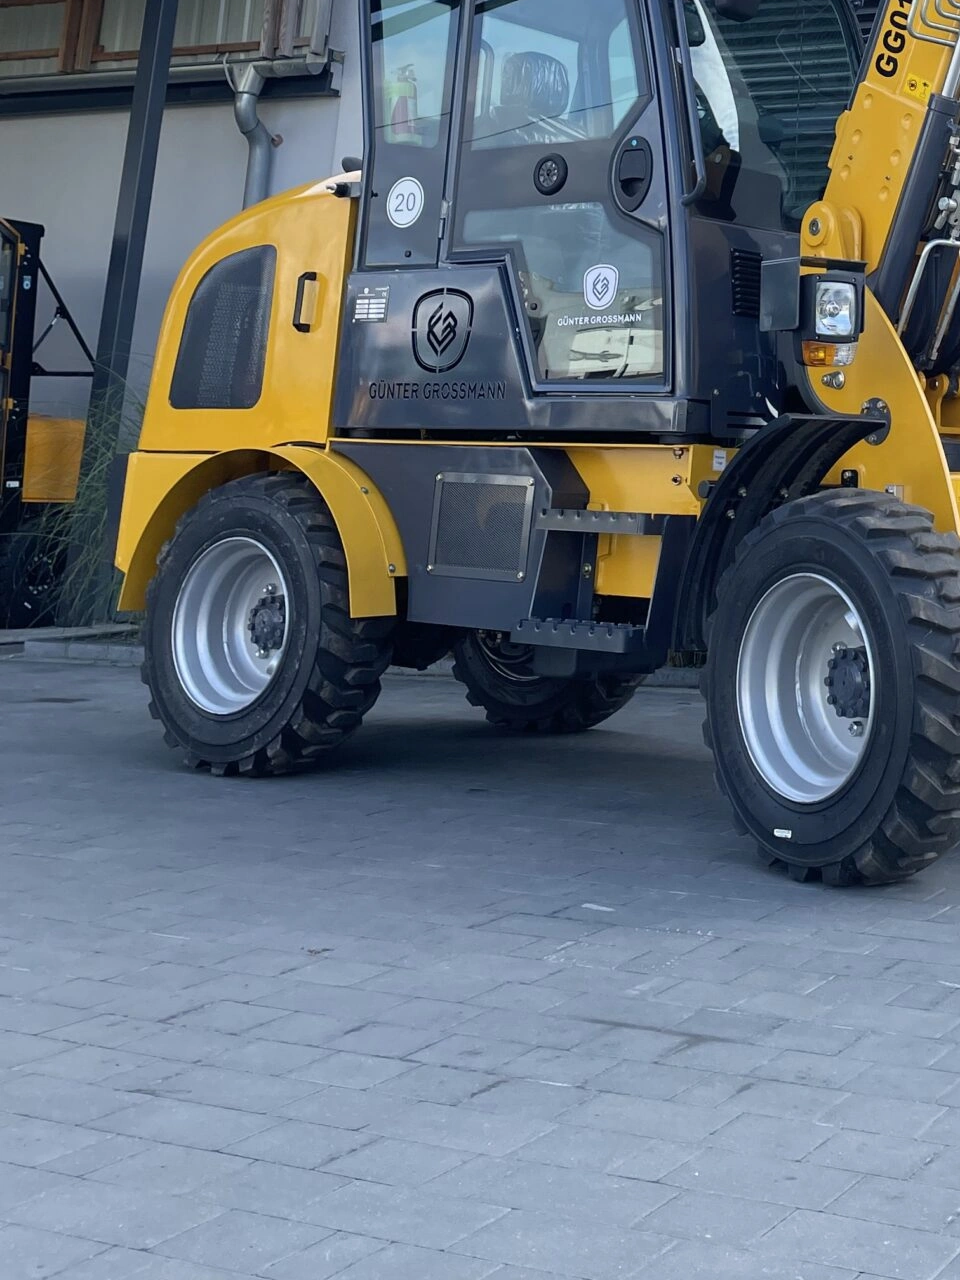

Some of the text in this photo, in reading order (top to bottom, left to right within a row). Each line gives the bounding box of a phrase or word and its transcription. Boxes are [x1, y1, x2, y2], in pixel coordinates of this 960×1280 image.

[394, 192, 416, 212] 20
[557, 313, 642, 327] GÜNTER GROSSMANN
[368, 379, 507, 400] GÜNTER GROSSMANN
